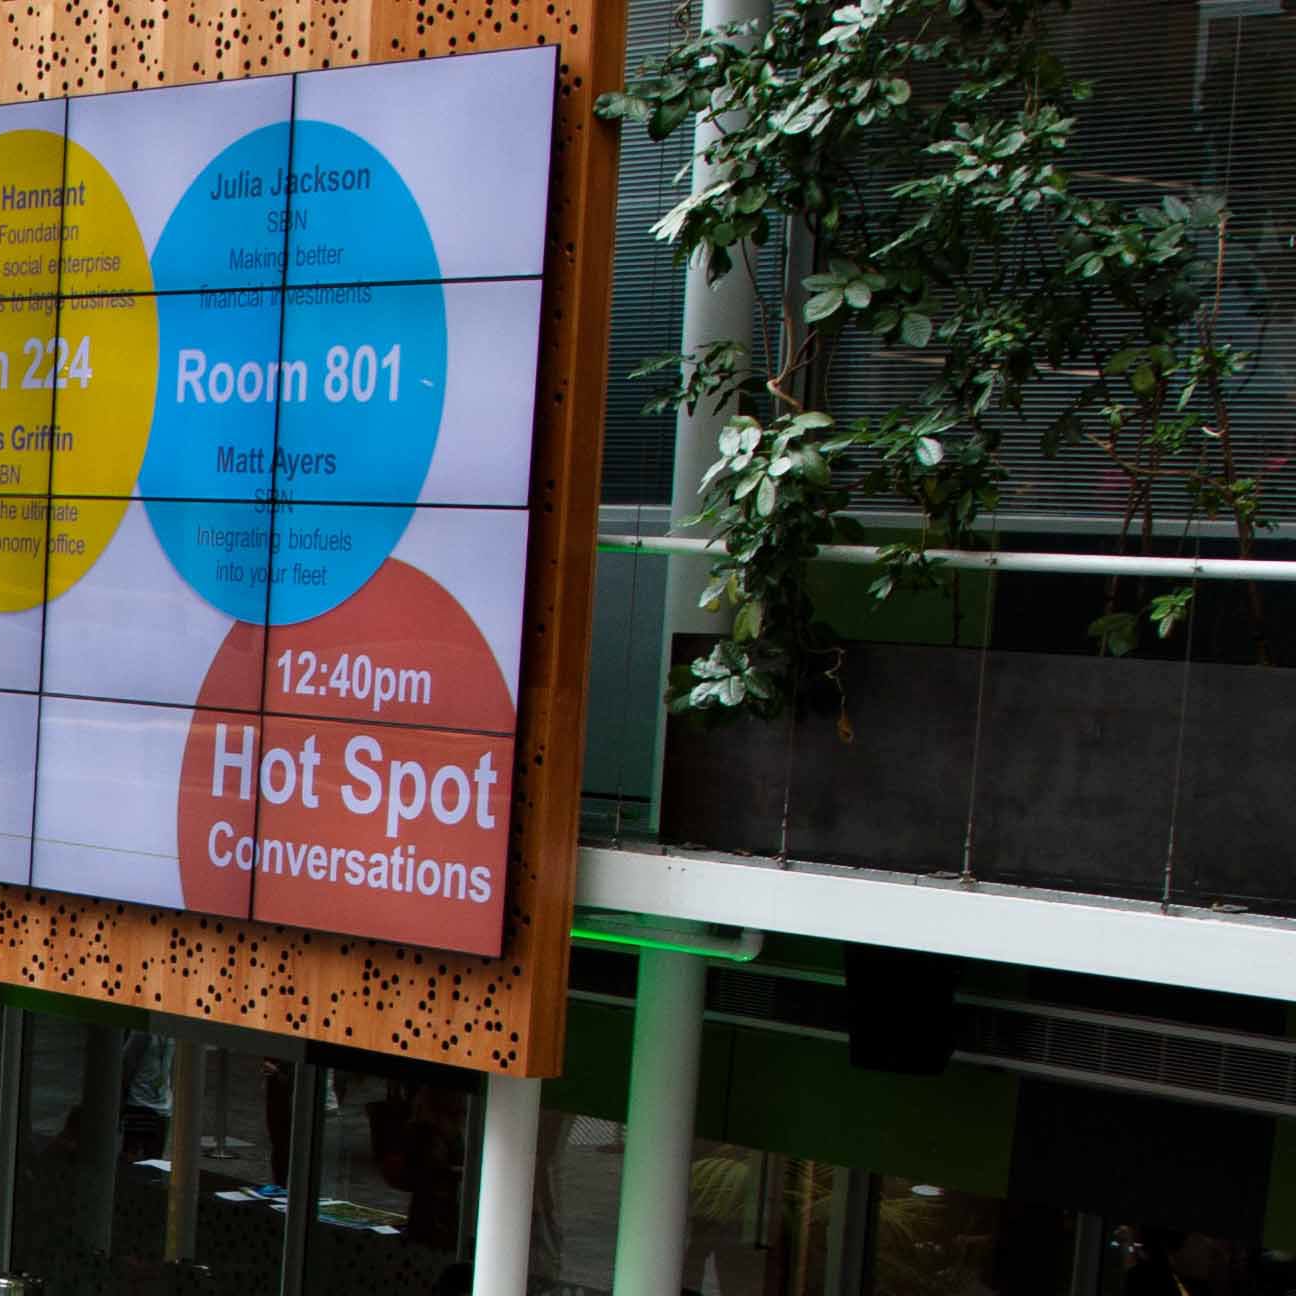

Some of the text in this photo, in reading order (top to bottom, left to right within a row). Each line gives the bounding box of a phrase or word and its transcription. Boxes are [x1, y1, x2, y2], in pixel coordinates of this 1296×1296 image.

[2, 180, 85, 211] Hannant
[211, 163, 370, 200] Julia Jackson
[0, 223, 79, 245] Foundation
[267, 208, 307, 233] SBN
[3, 256, 42, 277] social
[48, 252, 121, 278] enterprise
[229, 243, 344, 273] Making better
[199, 281, 373, 310] financial investments
[20, 336, 93, 391] 224
[176, 343, 401, 403] Room 801
[10, 425, 73, 452] Griffin
[216, 446, 337, 481] Matt Ayers
[22, 502, 78, 522] ultimate
[48, 532, 86, 555] office
[197, 526, 353, 554] Integrating biofuels
[216, 560, 328, 589] into your fleet
[277, 648, 432, 712] 12:40pm
[211, 722, 497, 838] Hot Spot
[208, 820, 492, 903] Conversations
